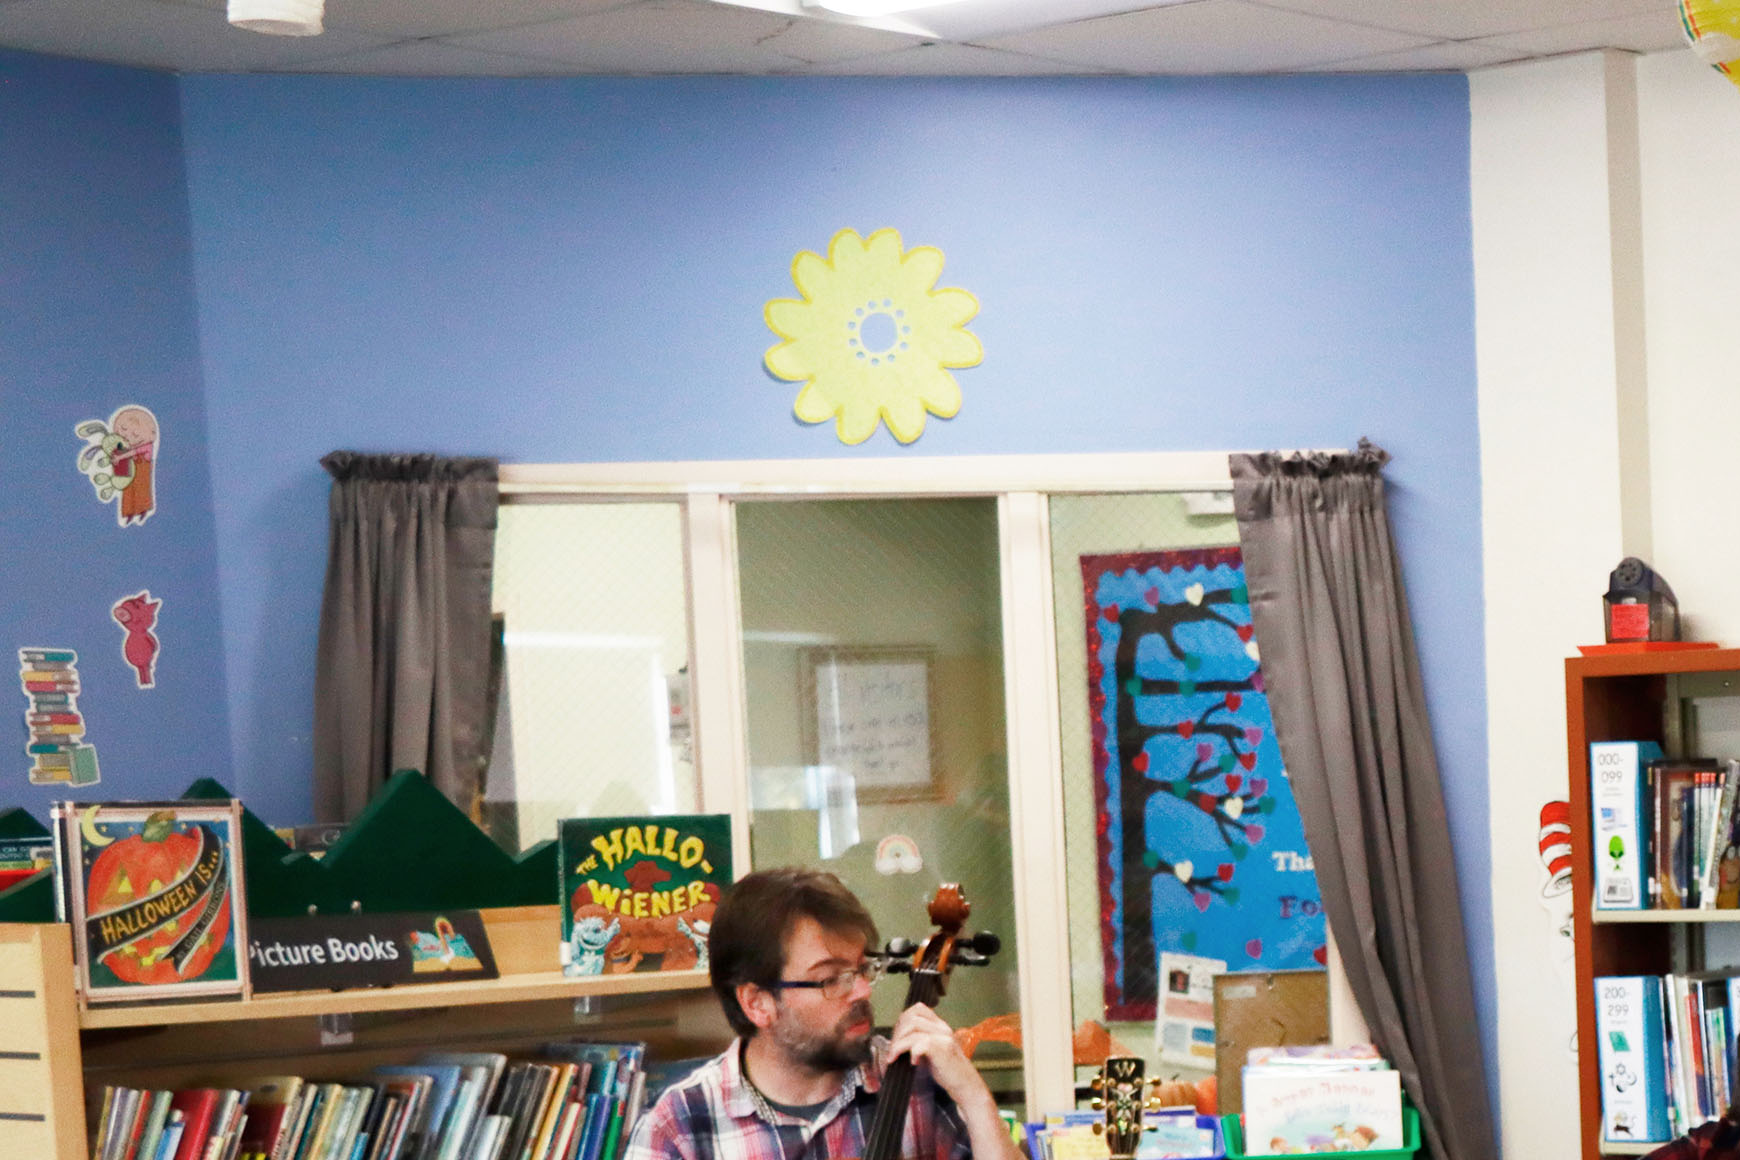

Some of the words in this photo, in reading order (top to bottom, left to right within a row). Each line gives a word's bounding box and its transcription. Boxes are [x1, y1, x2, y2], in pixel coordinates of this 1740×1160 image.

[1601, 771, 1623, 784] 099
[575, 853, 599, 876] THE
[590, 825, 714, 875] HALLO-
[100, 879, 198, 945] HALLOWEEN
[326, 933, 399, 963] Books
[1604, 986, 1630, 1000] 200-
[1607, 1004, 1629, 1018] 299
